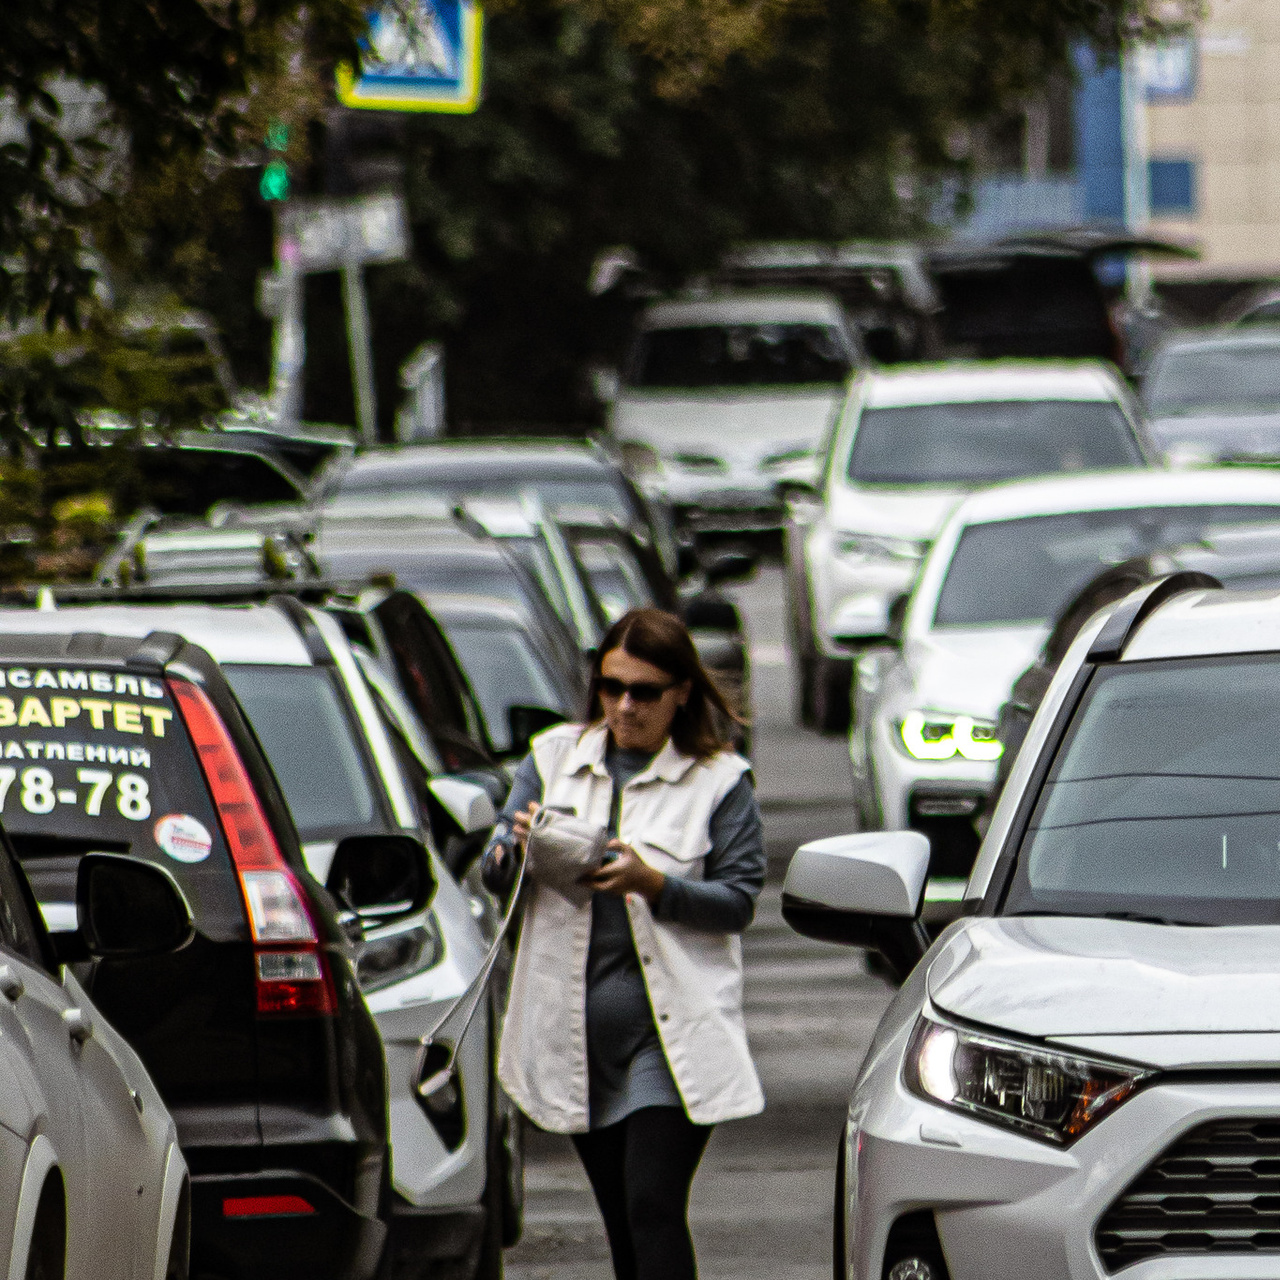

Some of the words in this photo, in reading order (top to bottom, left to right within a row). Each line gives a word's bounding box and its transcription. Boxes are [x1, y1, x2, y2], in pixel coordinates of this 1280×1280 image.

[0, 668, 164, 698] САМБЛЬ
[0, 695, 173, 738] ВАРТЕТ
[0, 740, 151, 769] АТЛЕНИЙ
